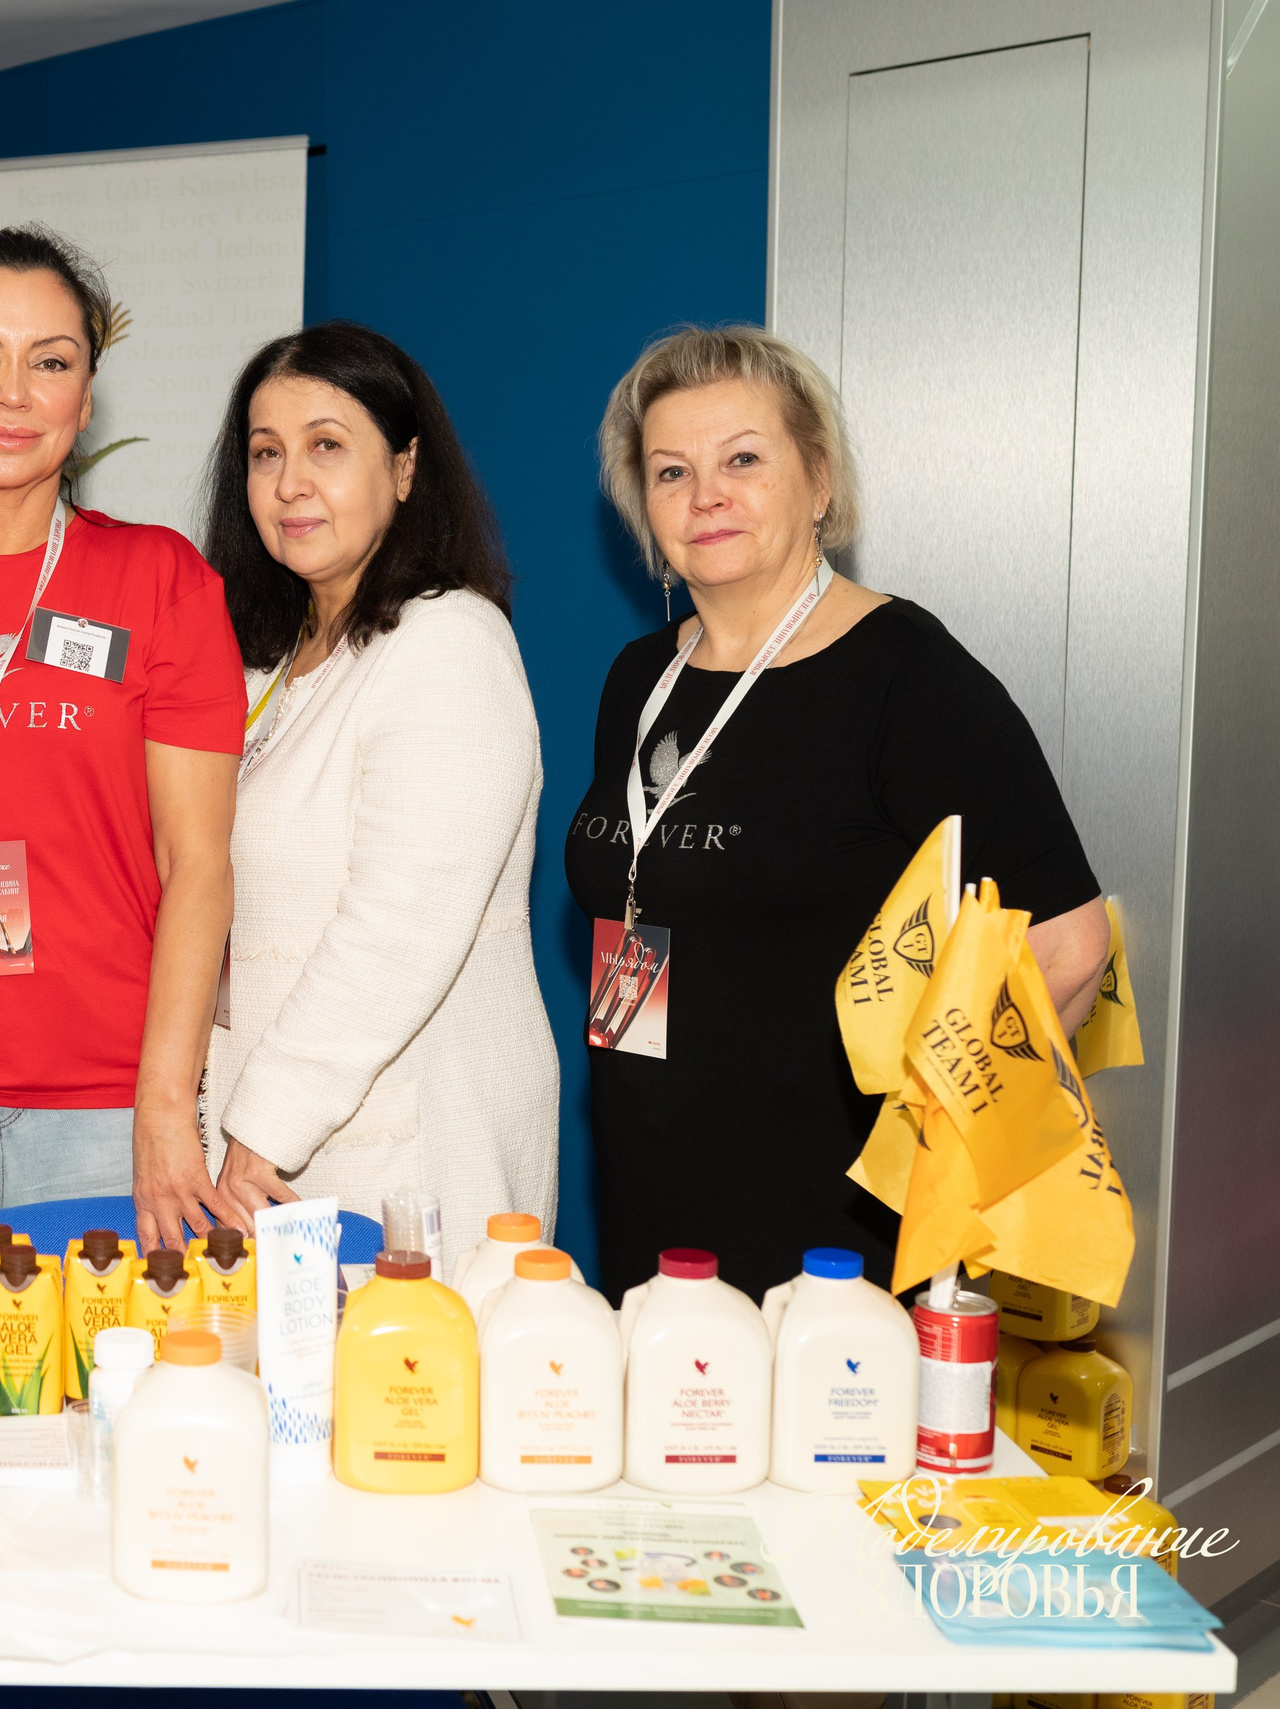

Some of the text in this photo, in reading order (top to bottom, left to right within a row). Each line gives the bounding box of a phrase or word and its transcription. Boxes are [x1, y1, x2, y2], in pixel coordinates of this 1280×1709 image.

[850, 950, 869, 988] AM
[869, 918, 895, 1002] LOBAL
[922, 1019, 982, 1098] TEAM
[945, 1007, 1004, 1104] GLOBAL
[284, 1275, 323, 1298] ALOE
[84, 1305, 120, 1316] ALOE
[207, 1295, 248, 1303] FOREVER
[284, 1294, 327, 1318] BODY
[0, 1321, 36, 1333] ALOE
[82, 1316, 121, 1328] VERA
[279, 1312, 335, 1338] LOTION
[0, 1333, 38, 1344] VERA
[4, 1344, 34, 1356] GEL
